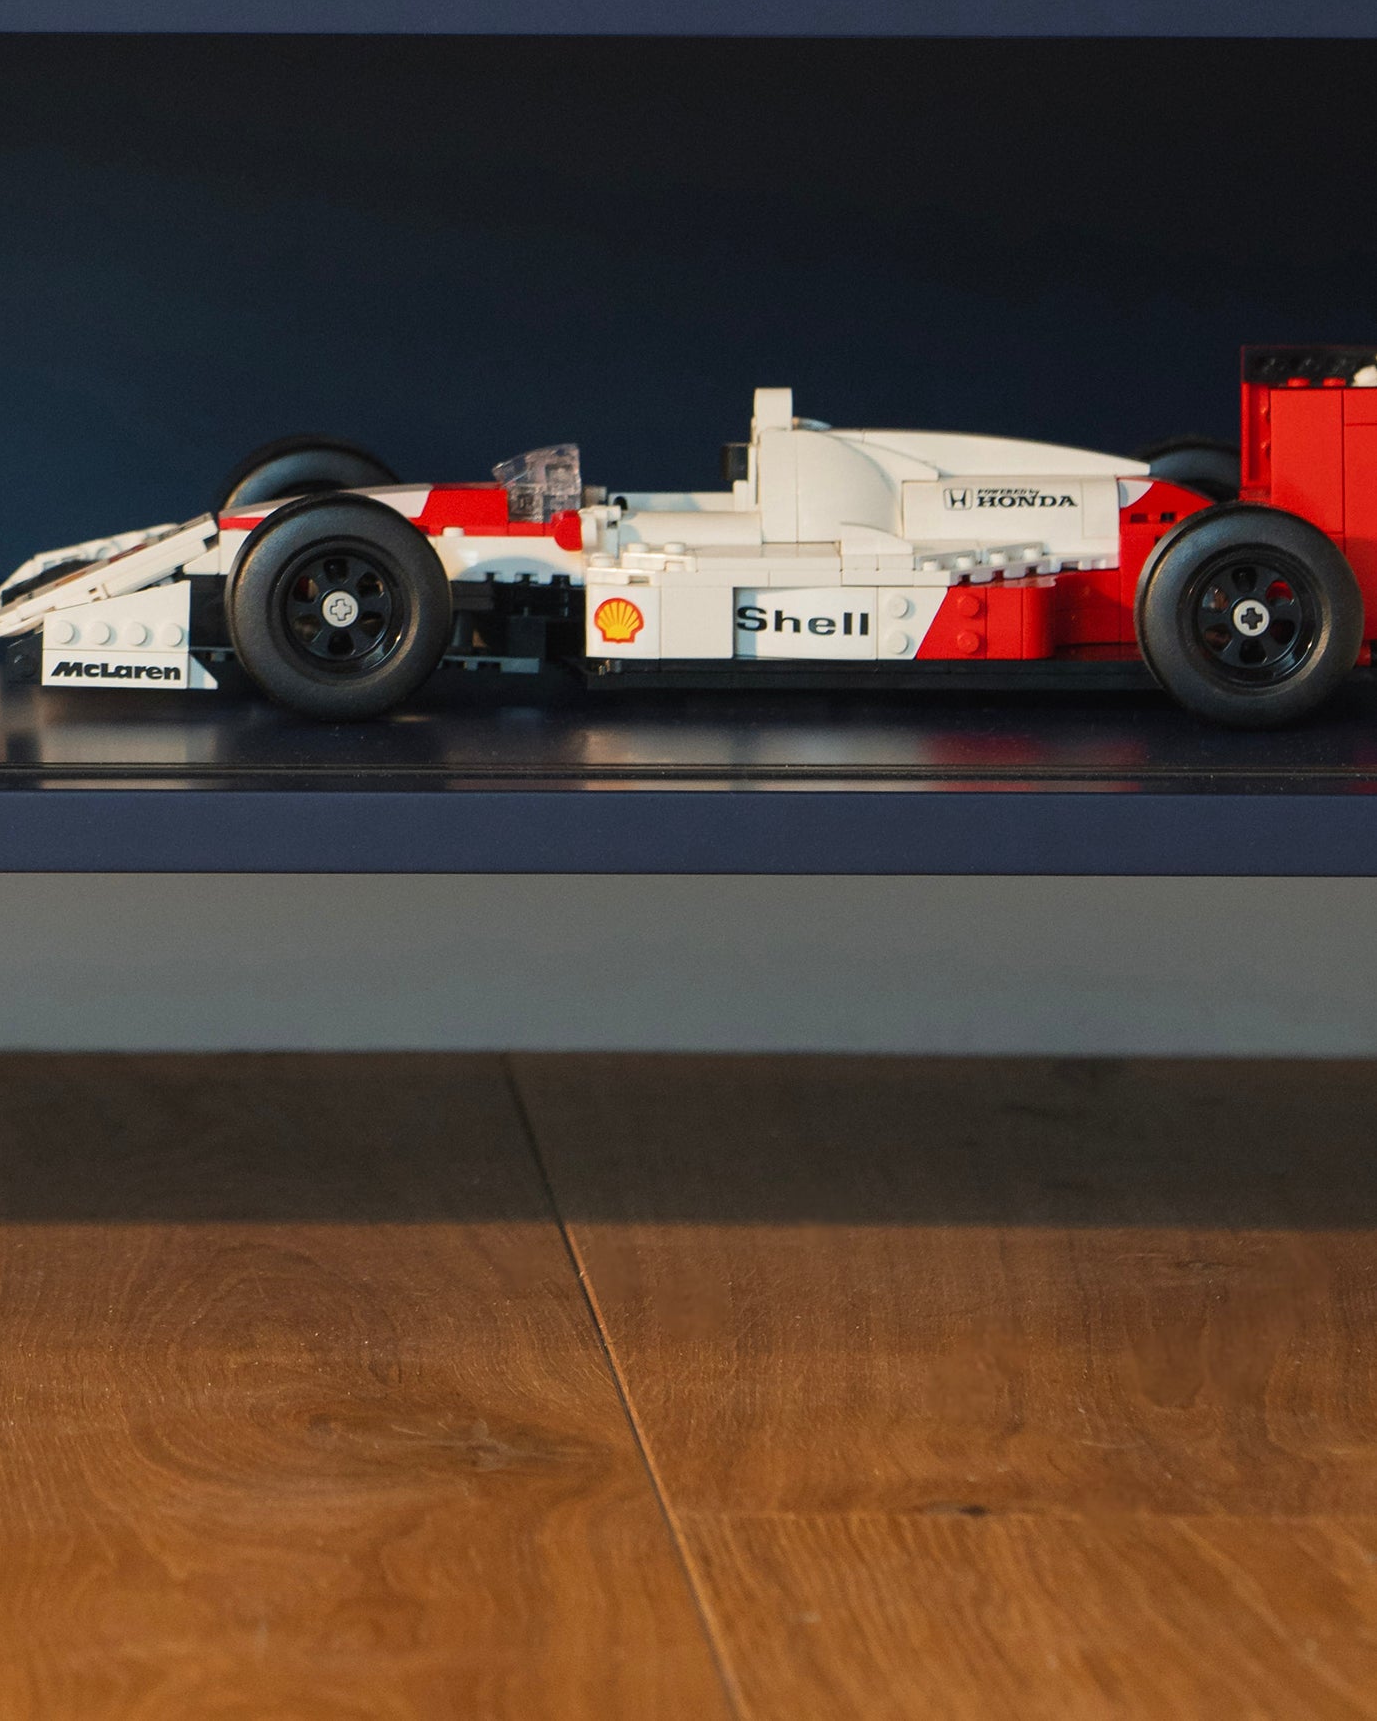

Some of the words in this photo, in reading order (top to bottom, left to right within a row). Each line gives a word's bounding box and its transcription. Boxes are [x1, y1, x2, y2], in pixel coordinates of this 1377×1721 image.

[977, 487, 1027, 496] POWERED
[976, 495, 1079, 508] HONDA
[736, 606, 869, 636] Shell
[51, 661, 181, 681] McLaren
